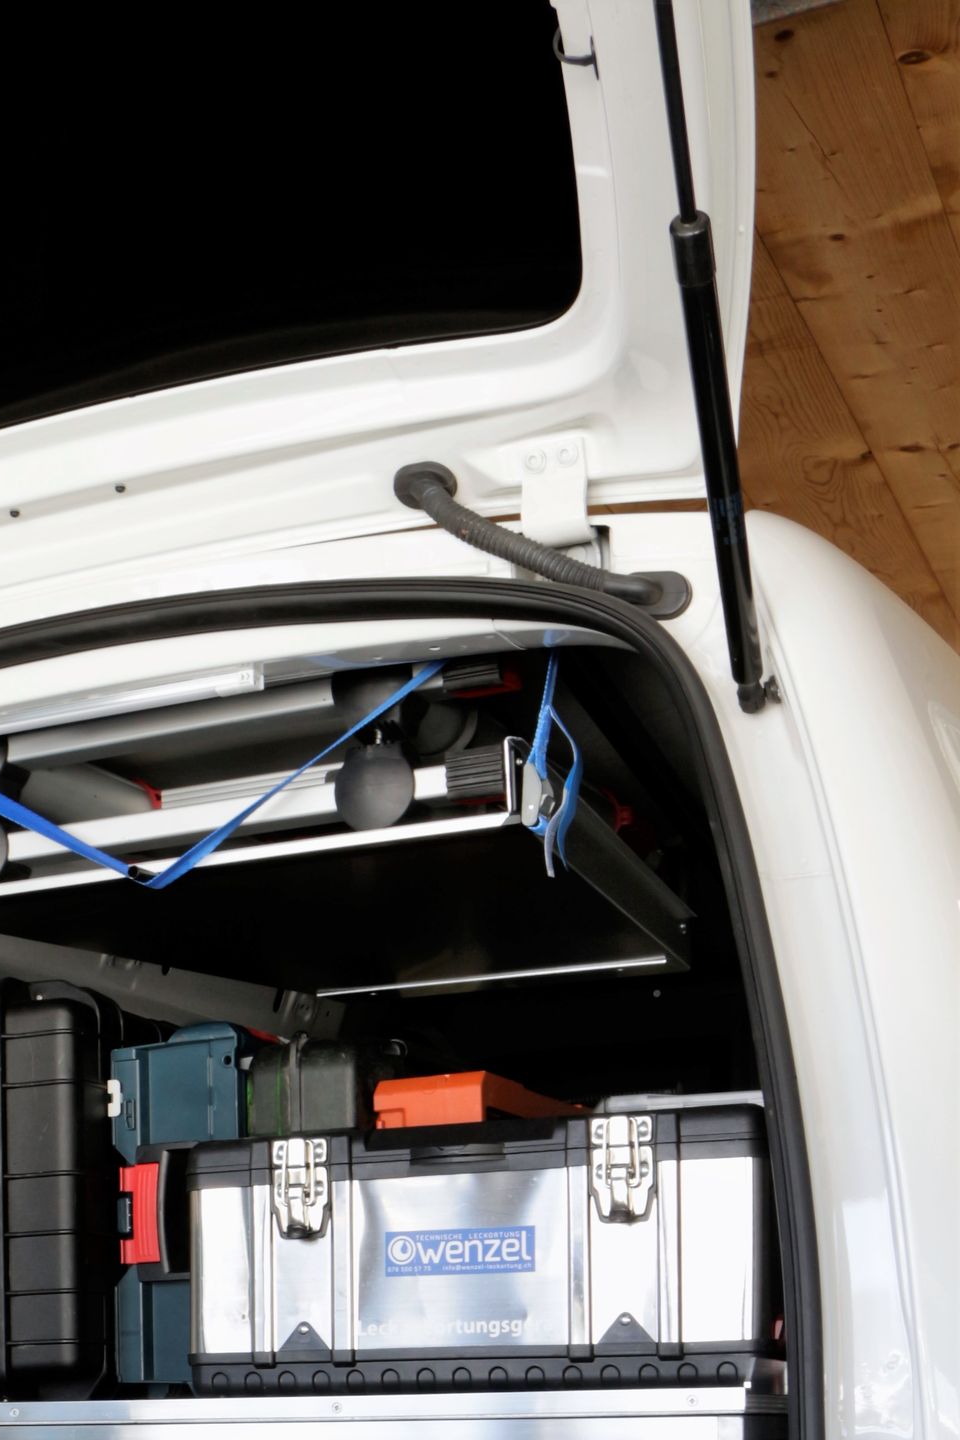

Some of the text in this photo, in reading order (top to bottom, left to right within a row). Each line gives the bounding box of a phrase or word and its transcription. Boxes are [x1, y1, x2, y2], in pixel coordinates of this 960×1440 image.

[415, 1230, 520, 1241] TECHNISCHE LECKORTUNG
[416, 1230, 532, 1265] wenzel
